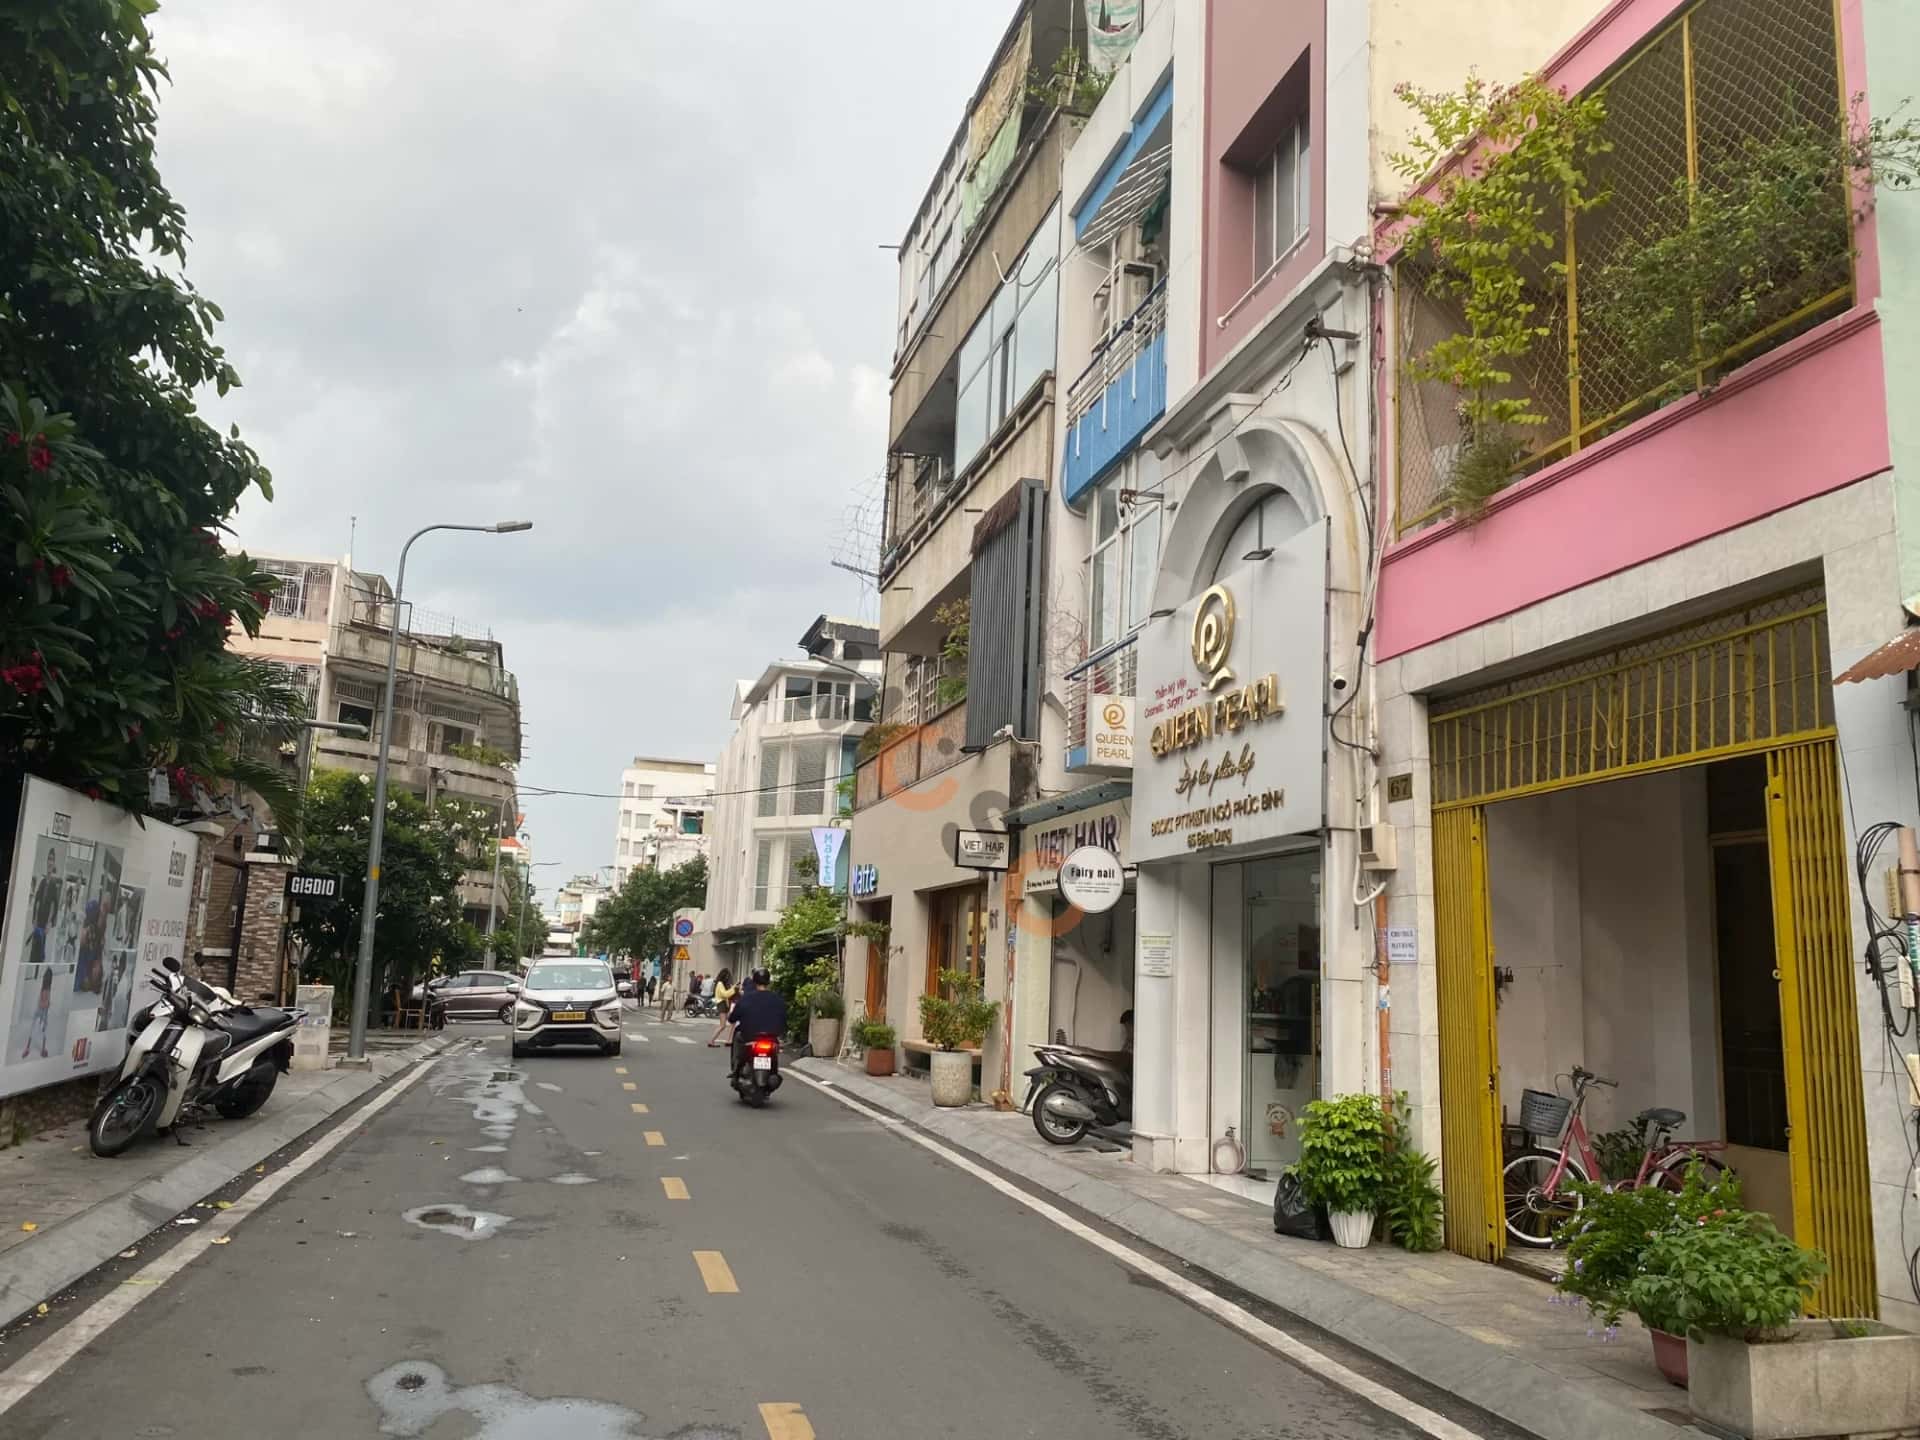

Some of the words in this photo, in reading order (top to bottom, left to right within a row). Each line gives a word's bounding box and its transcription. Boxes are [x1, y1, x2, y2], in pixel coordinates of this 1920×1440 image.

[1151, 702, 1213, 758] QUEEN
[1214, 672, 1286, 736] PEARL
[1095, 732, 1134, 746] QUEEN
[1096, 747, 1131, 760] PEARL
[1390, 777, 1409, 798] 67
[1074, 814, 1121, 856] HAIR
[985, 840, 1005, 853] HAIR
[1070, 866, 1094, 880] Fairy
[1097, 867, 1115, 879] nail
[290, 876, 336, 897] GISDIO
